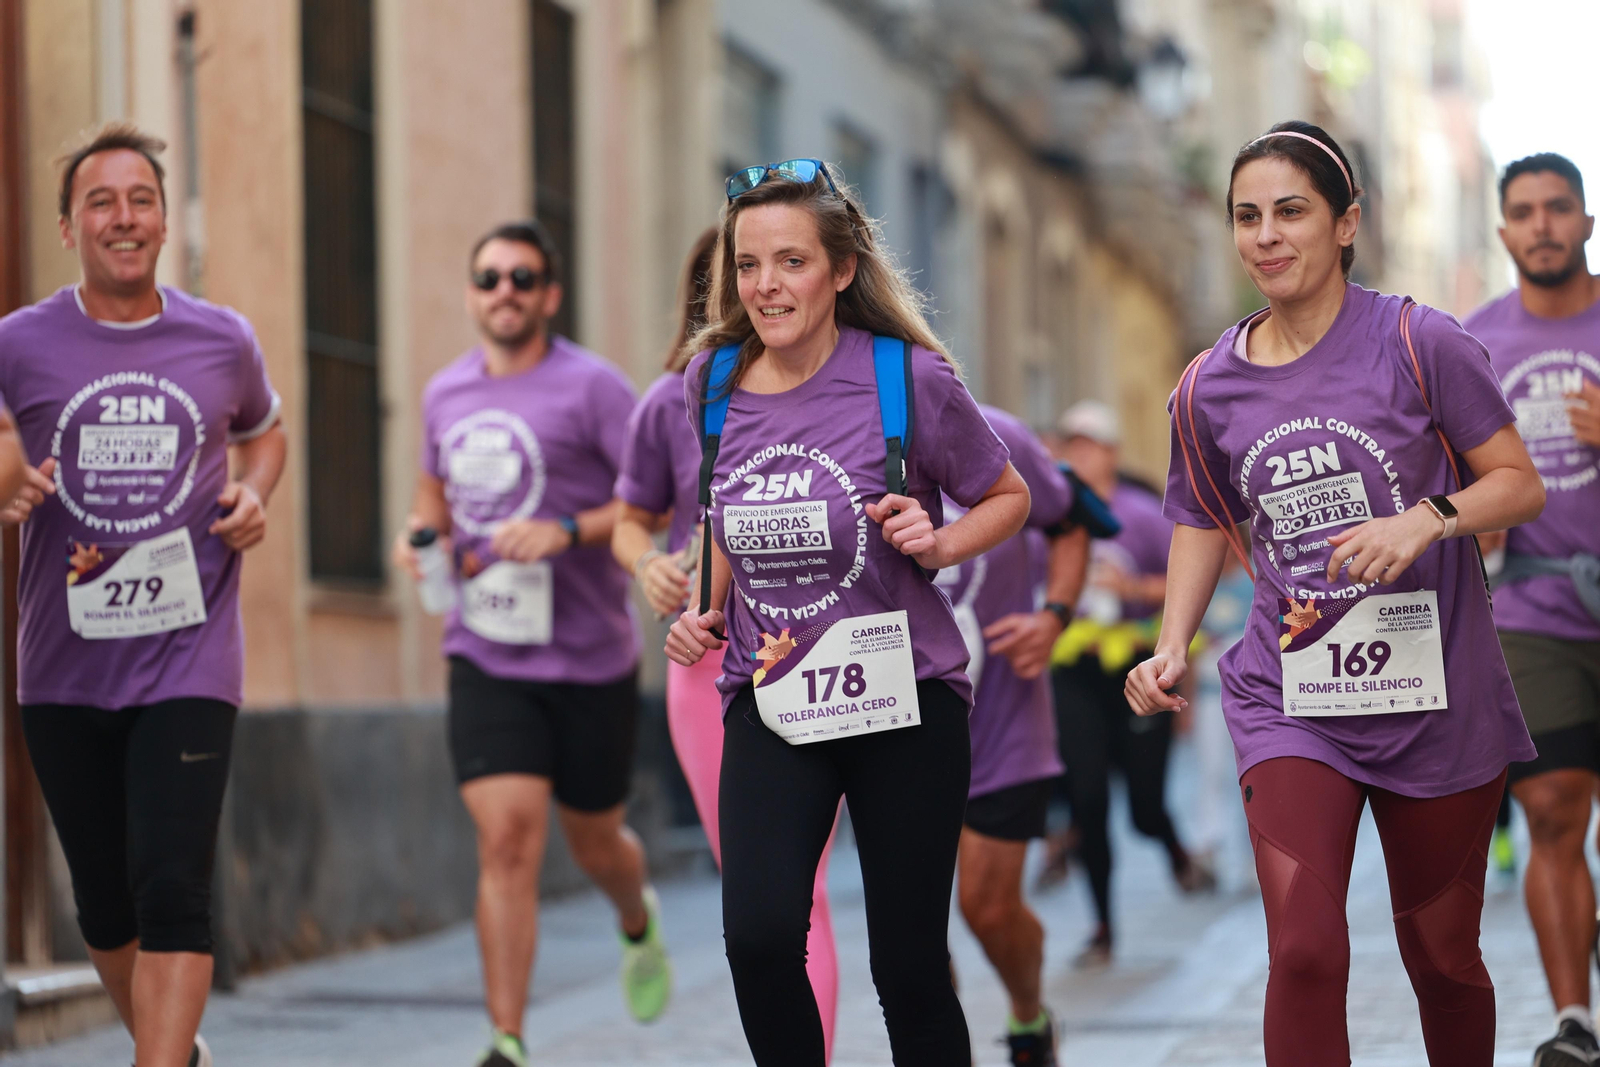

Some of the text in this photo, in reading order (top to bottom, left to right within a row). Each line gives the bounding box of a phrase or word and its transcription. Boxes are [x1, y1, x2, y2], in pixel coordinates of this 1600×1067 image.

[57, 371, 156, 431] INTERNACIONAL
[99, 395, 165, 423] 25N
[158, 378, 202, 426] CONTRA
[195, 423, 206, 446] LA
[1240, 417, 1399, 499] INTERNACIONAL CONTRA LA
[1265, 441, 1342, 486] 25N
[808, 448, 857, 495] CONTRA
[742, 469, 813, 501] 25N
[1263, 476, 1359, 505] SERVICIO DE EMERGENCIAS
[726, 505, 823, 517] SERVICIO DE EMERGENCIAS
[850, 494, 863, 515] LA
[1278, 502, 1295, 516] 24
[1296, 487, 1351, 512] HORAS
[85, 513, 112, 533] LAS
[114, 511, 161, 533] HACIA
[737, 516, 810, 533] 24 HORAS
[1276, 502, 1365, 534] 900 21 21 30
[730, 532, 823, 550] 900 21 21 30
[1298, 537, 1331, 554] Ayuntamie
[839, 516, 868, 589] VIOLENCIA
[757, 560, 799, 571] Ayuntamiento
[1291, 564, 1308, 574] fmm
[104, 576, 163, 607] 279
[1298, 589, 1325, 600] LAS
[1329, 578, 1379, 600] ACIA
[759, 602, 789, 620] LAS
[791, 590, 840, 620] HACIA
[1379, 603, 1431, 616] CARRERA
[1397, 613, 1432, 621] ELIMINACIÓN
[852, 624, 902, 639] CARRERA
[875, 638, 904, 646] VIOLENCIA
[1327, 640, 1391, 678] 169
[801, 663, 867, 704] 178
[1298, 677, 1423, 694] ROMPE EL SILENCIO
[778, 696, 897, 725] TOLERANCIA CERO
